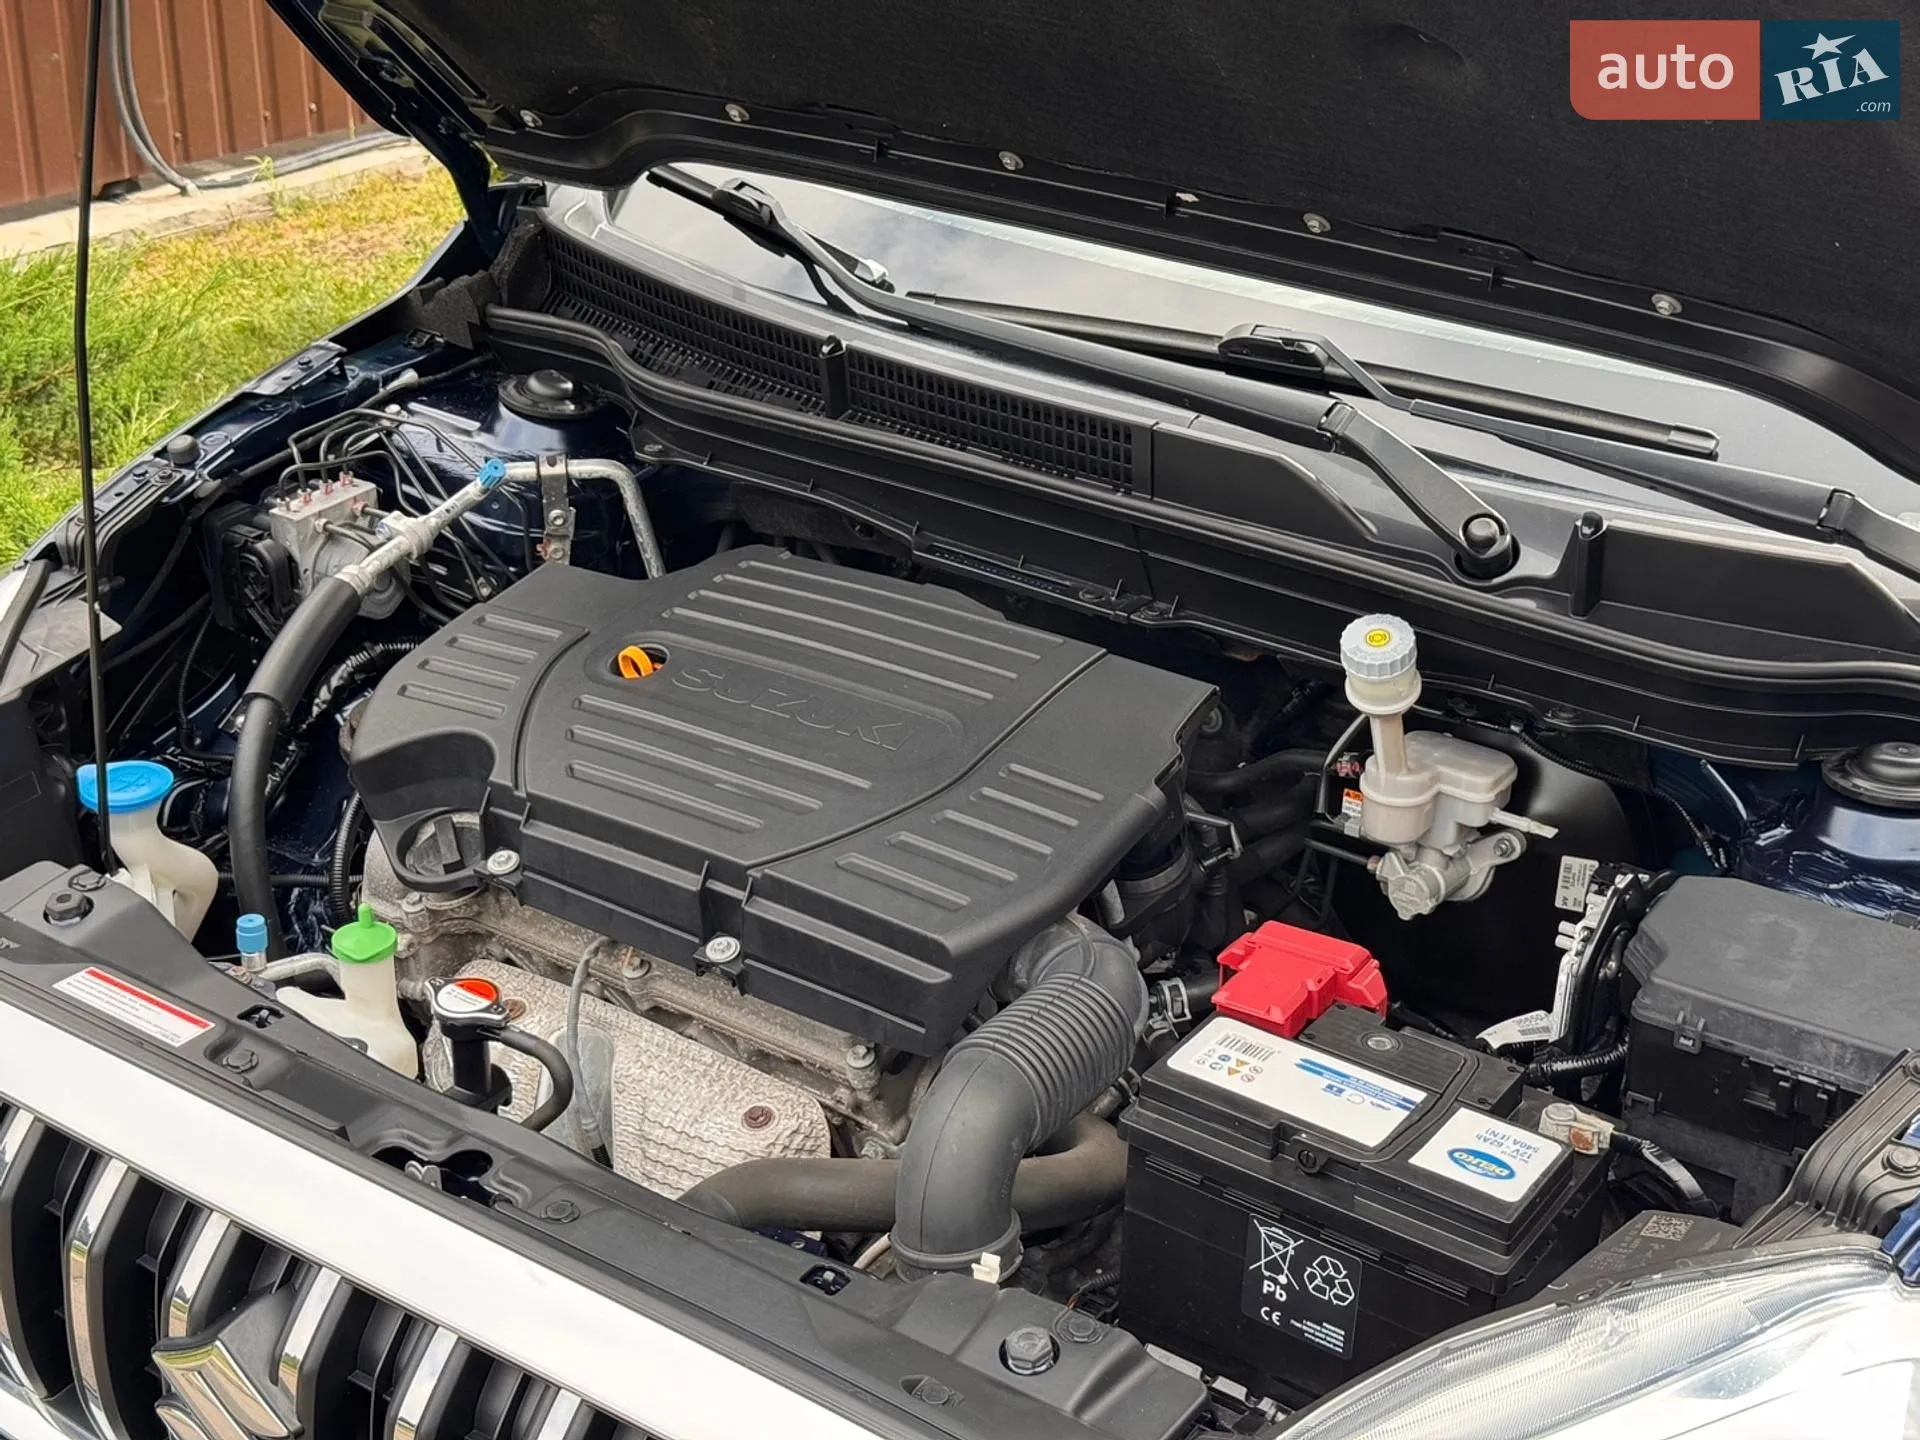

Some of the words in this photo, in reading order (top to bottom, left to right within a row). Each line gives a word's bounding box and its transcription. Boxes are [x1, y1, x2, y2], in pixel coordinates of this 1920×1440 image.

[671, 667, 916, 751] SUZUKI
[1511, 1147, 1533, 1160] 12V
[1262, 1279, 1287, 1302] Pb
[1260, 1306, 1282, 1326] CE
